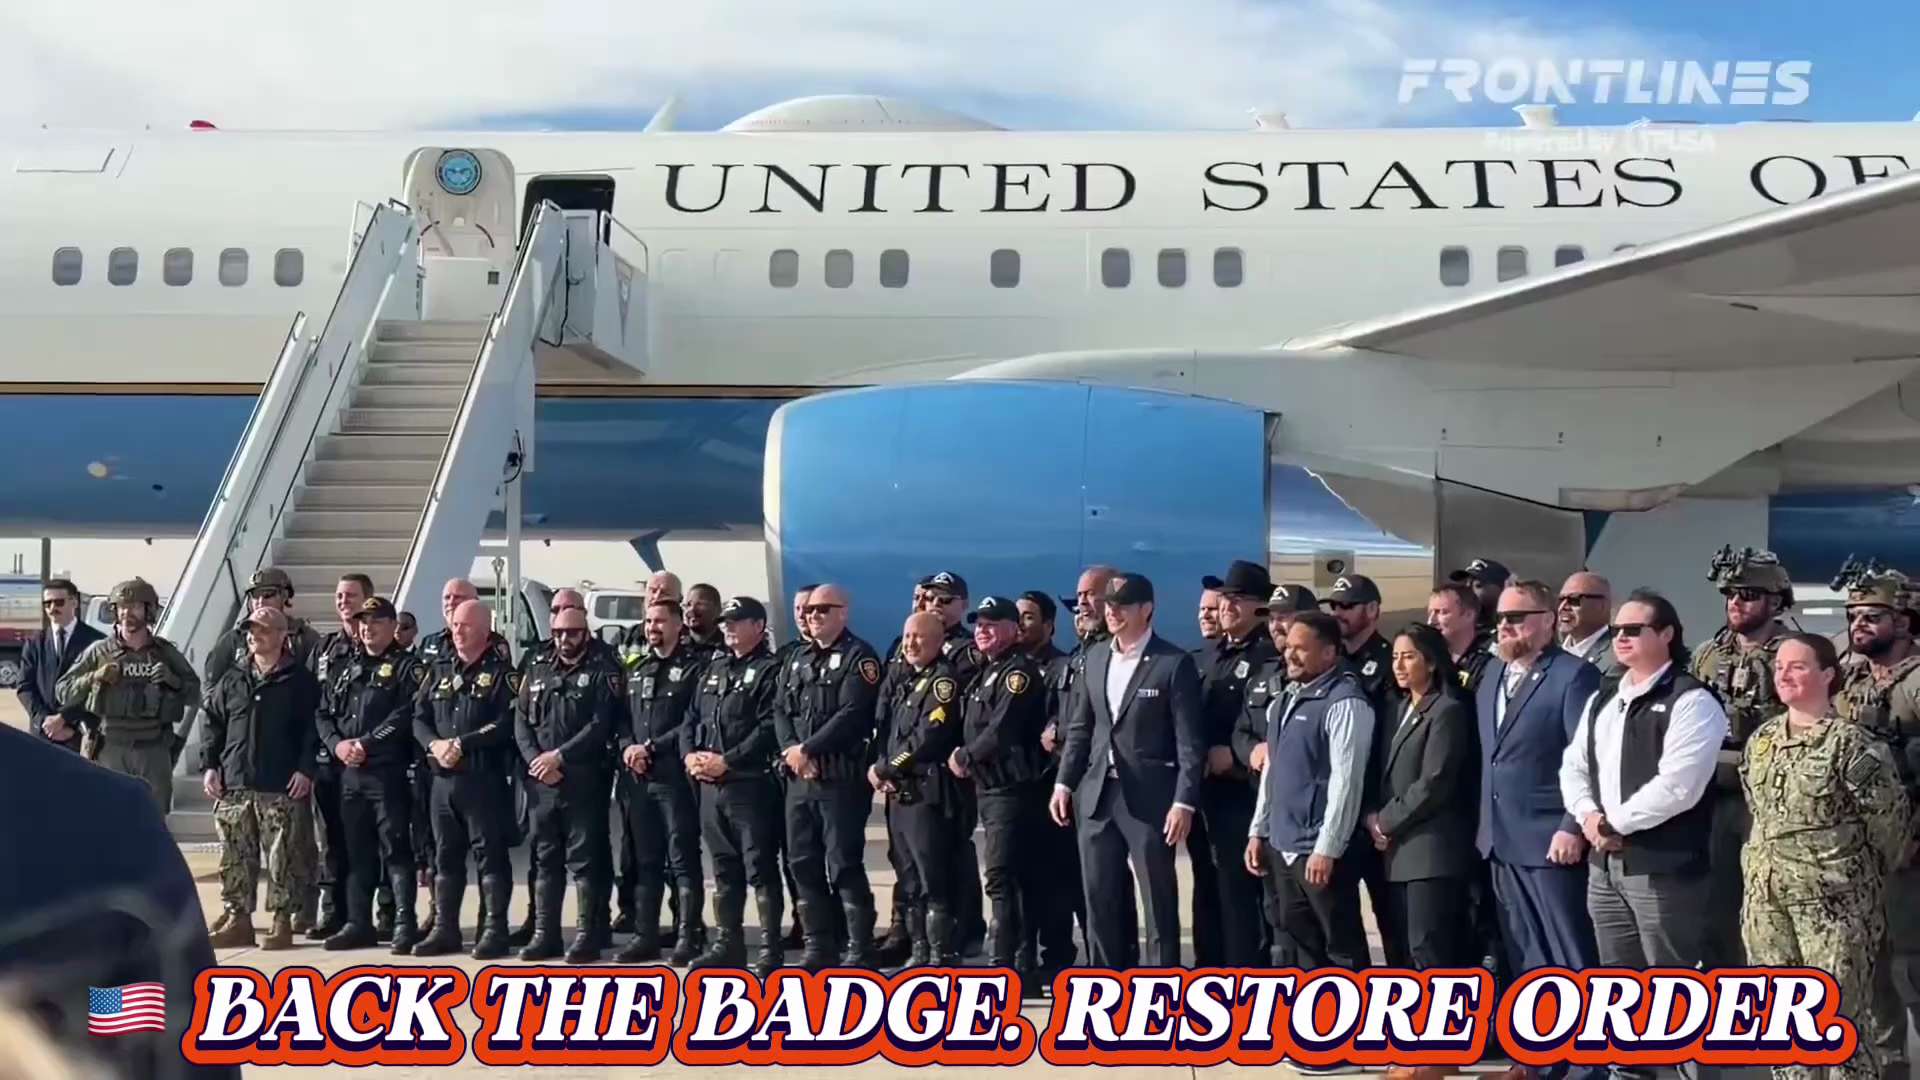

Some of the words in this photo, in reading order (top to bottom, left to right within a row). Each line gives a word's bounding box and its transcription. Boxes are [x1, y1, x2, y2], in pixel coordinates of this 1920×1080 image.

[656, 163, 1136, 213] UNITED
[1202, 157, 1683, 212] STATES
[123, 663, 151, 677] POLICE
